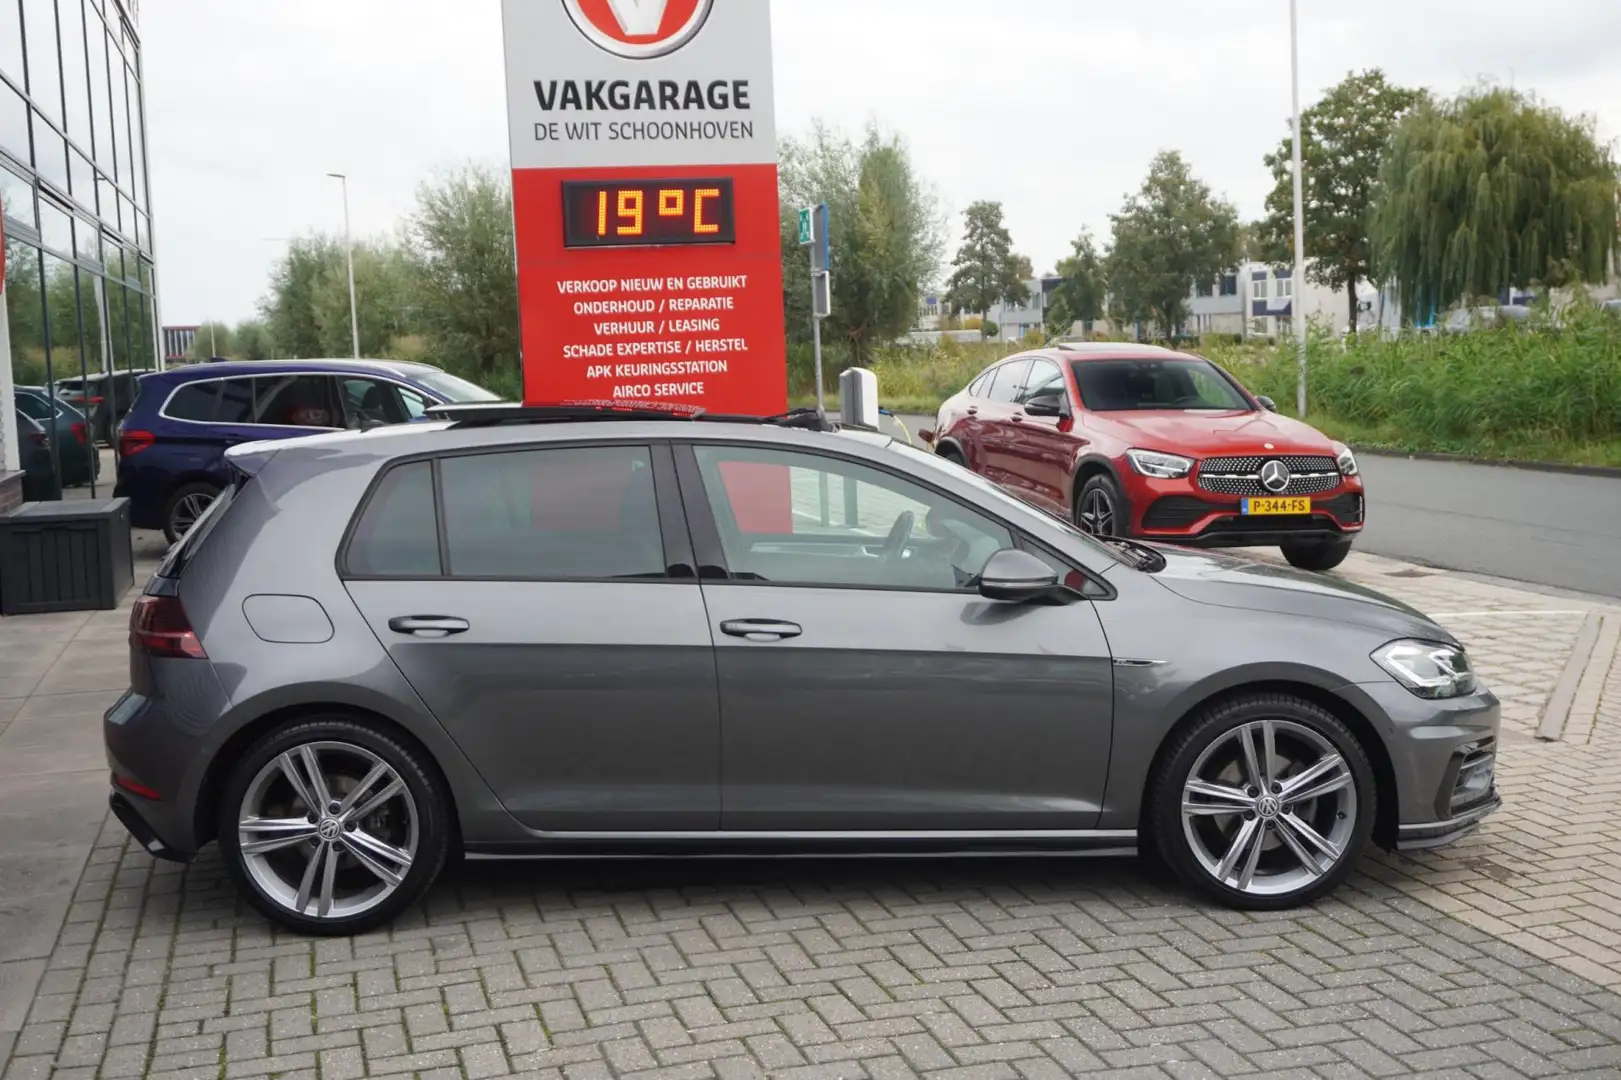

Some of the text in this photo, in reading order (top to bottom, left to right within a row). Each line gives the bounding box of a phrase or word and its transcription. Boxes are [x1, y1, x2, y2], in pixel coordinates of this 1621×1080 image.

[534, 80, 750, 110] VAKGARAGE
[535, 121, 752, 140] DE WIT SCHOONHOVEN
[557, 275, 747, 293] VERKOOP NIEUW EN GEBRUIKT
[574, 297, 733, 314] ONDERHOUD / REPARATIE
[594, 318, 720, 335] VERHUUR / LEASING
[563, 338, 748, 358] SCHADE EXPERTISE / HERSTEL
[587, 360, 727, 377] APK KEURINGSSTATION
[613, 382, 704, 398] AIRCO SERVICE
[1253, 500, 1306, 512] P-344-FS
